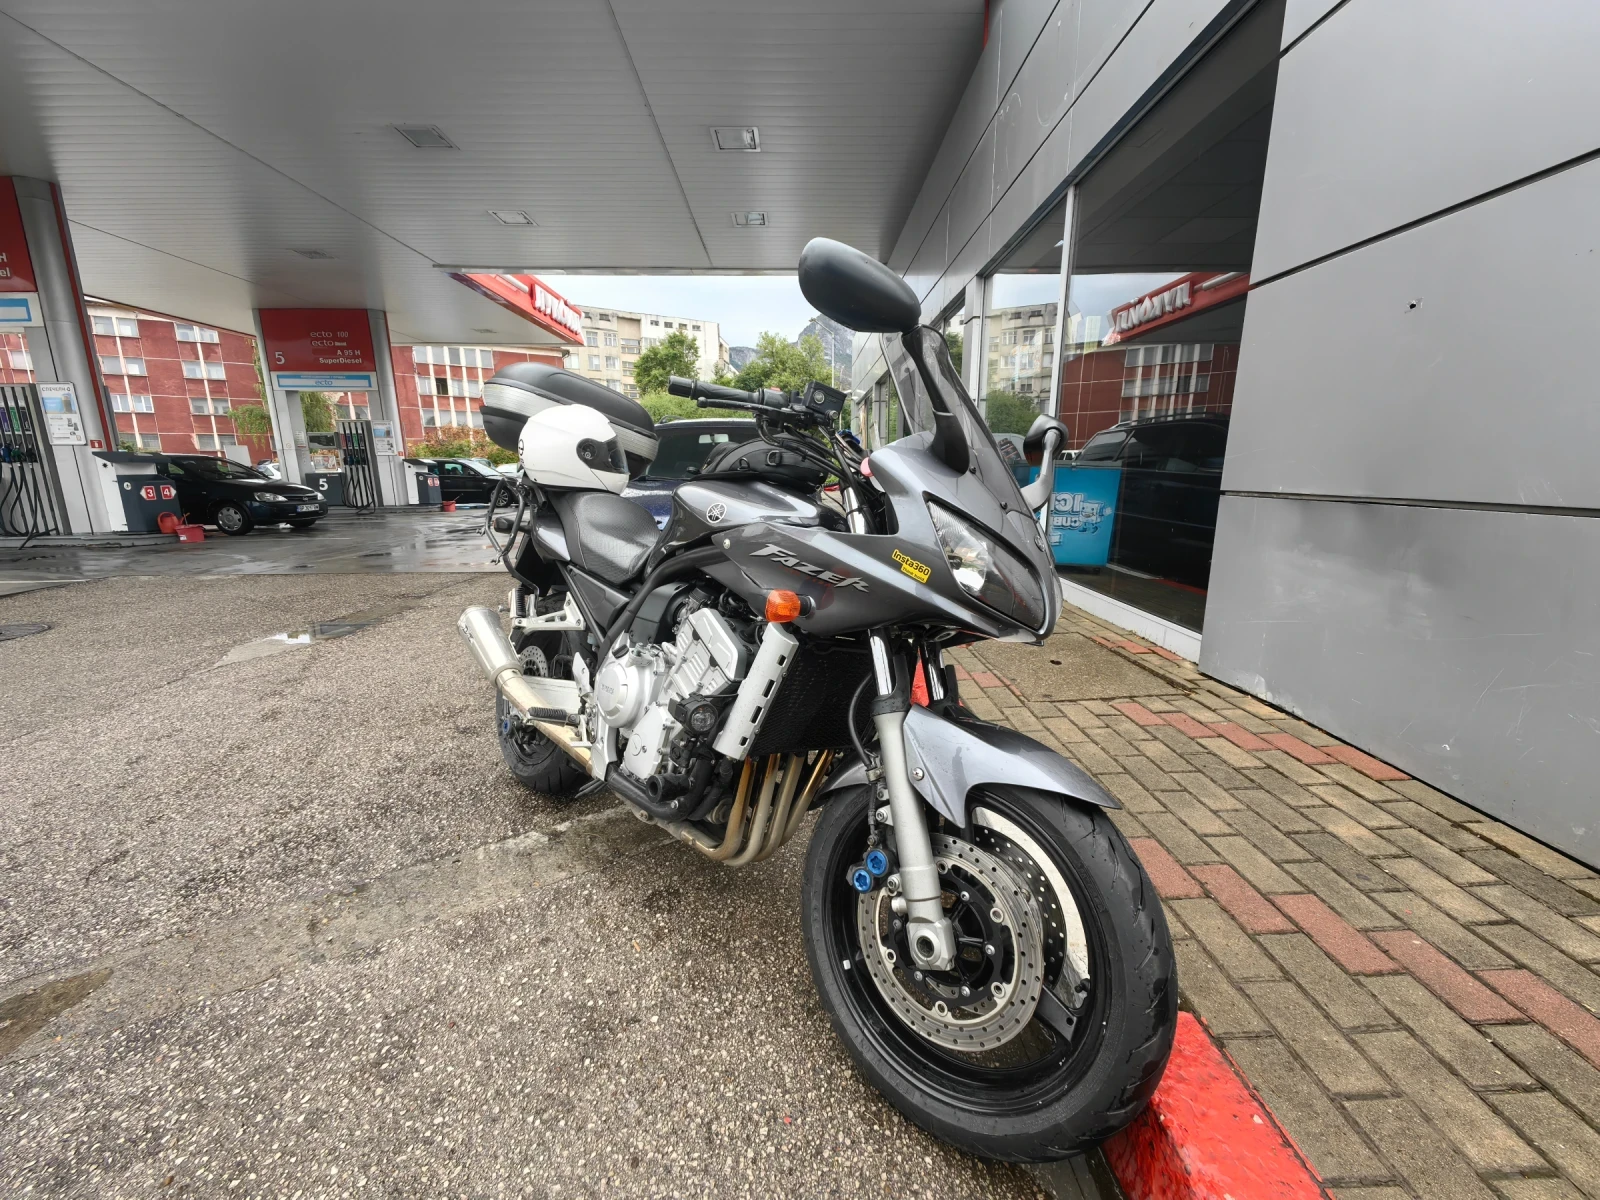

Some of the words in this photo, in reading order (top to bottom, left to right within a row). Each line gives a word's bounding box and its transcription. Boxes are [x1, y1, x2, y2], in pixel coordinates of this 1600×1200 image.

[275, 352, 285, 364] 5
[319, 478, 329, 491] 5
[146, 488, 154, 498] 3
[163, 488, 171, 497] 4
[749, 543, 870, 593] FAZER
[893, 550, 931, 576] Insta360
